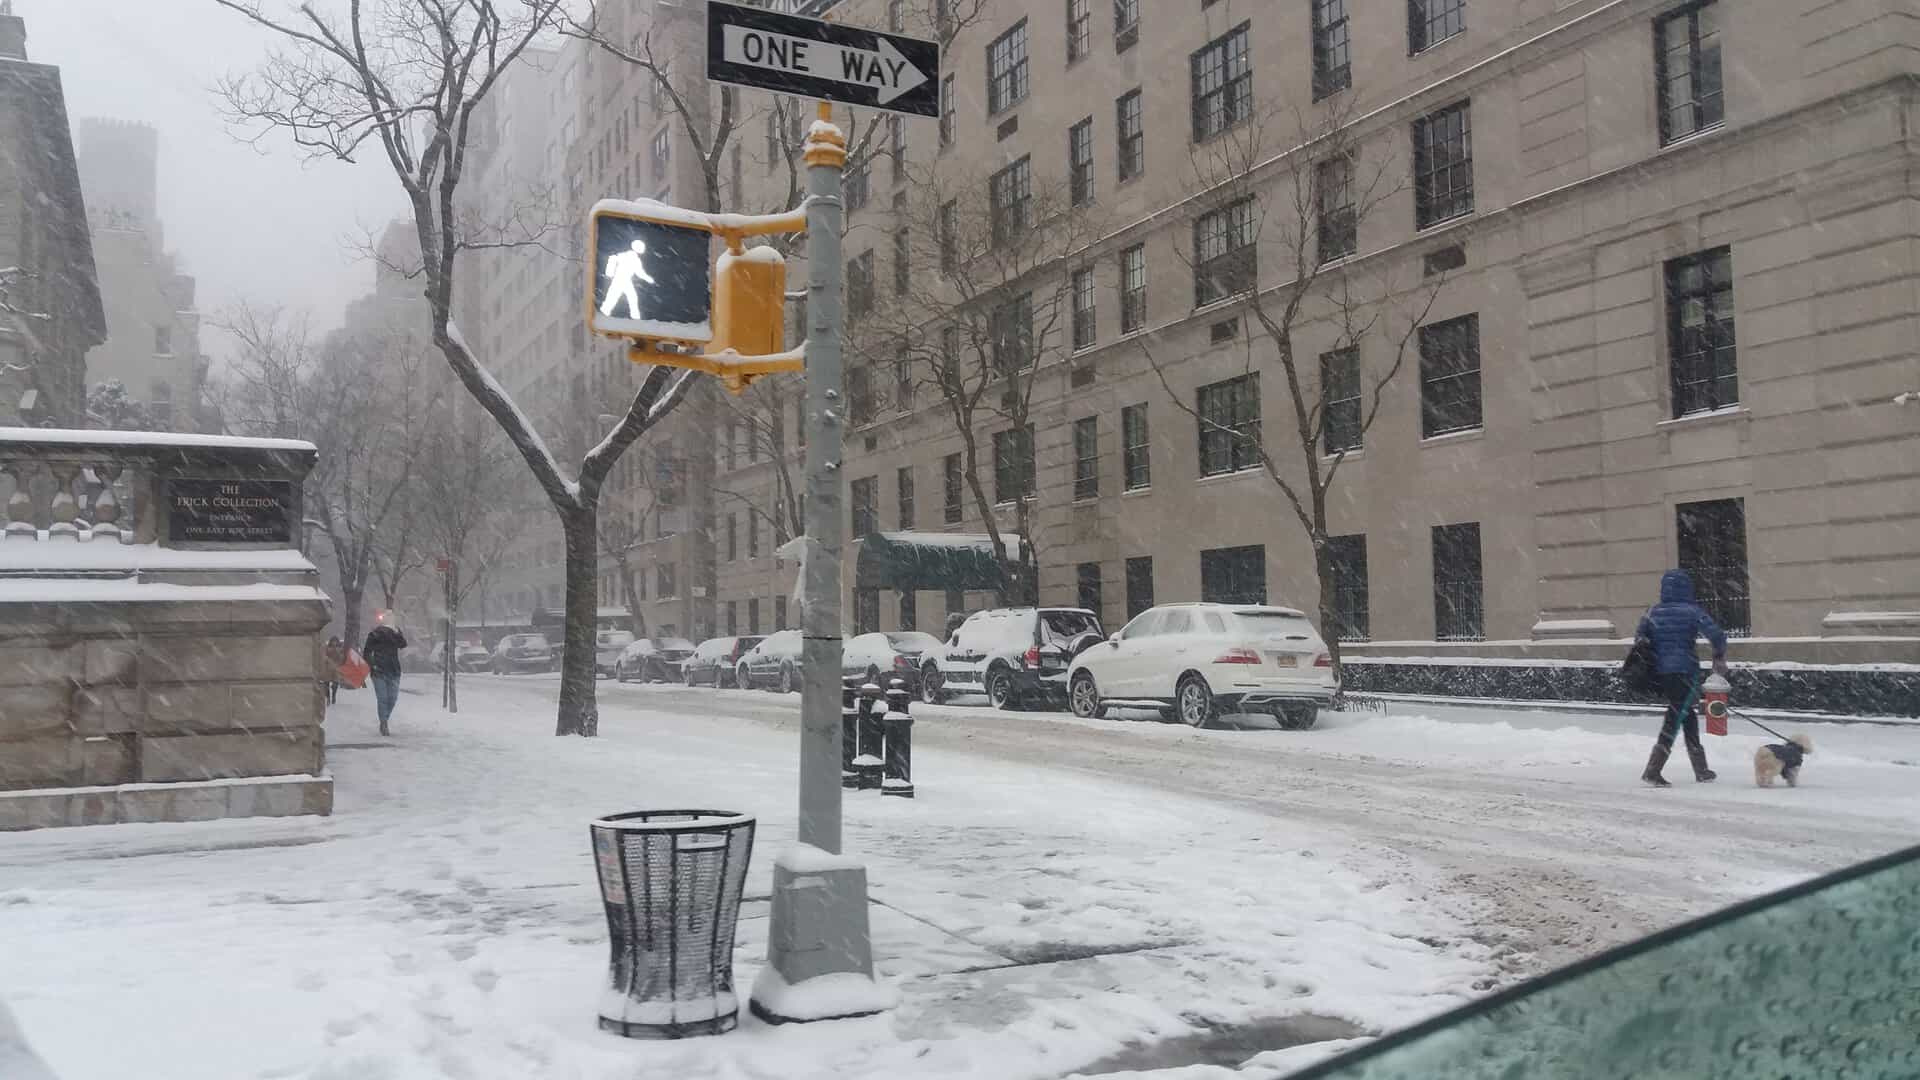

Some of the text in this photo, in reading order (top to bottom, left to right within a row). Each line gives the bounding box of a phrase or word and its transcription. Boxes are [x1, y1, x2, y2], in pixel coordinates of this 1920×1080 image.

[742, 32, 906, 88] ONE WAY
[221, 485, 240, 495] THE
[177, 497, 279, 508] FRICK COLLECTION
